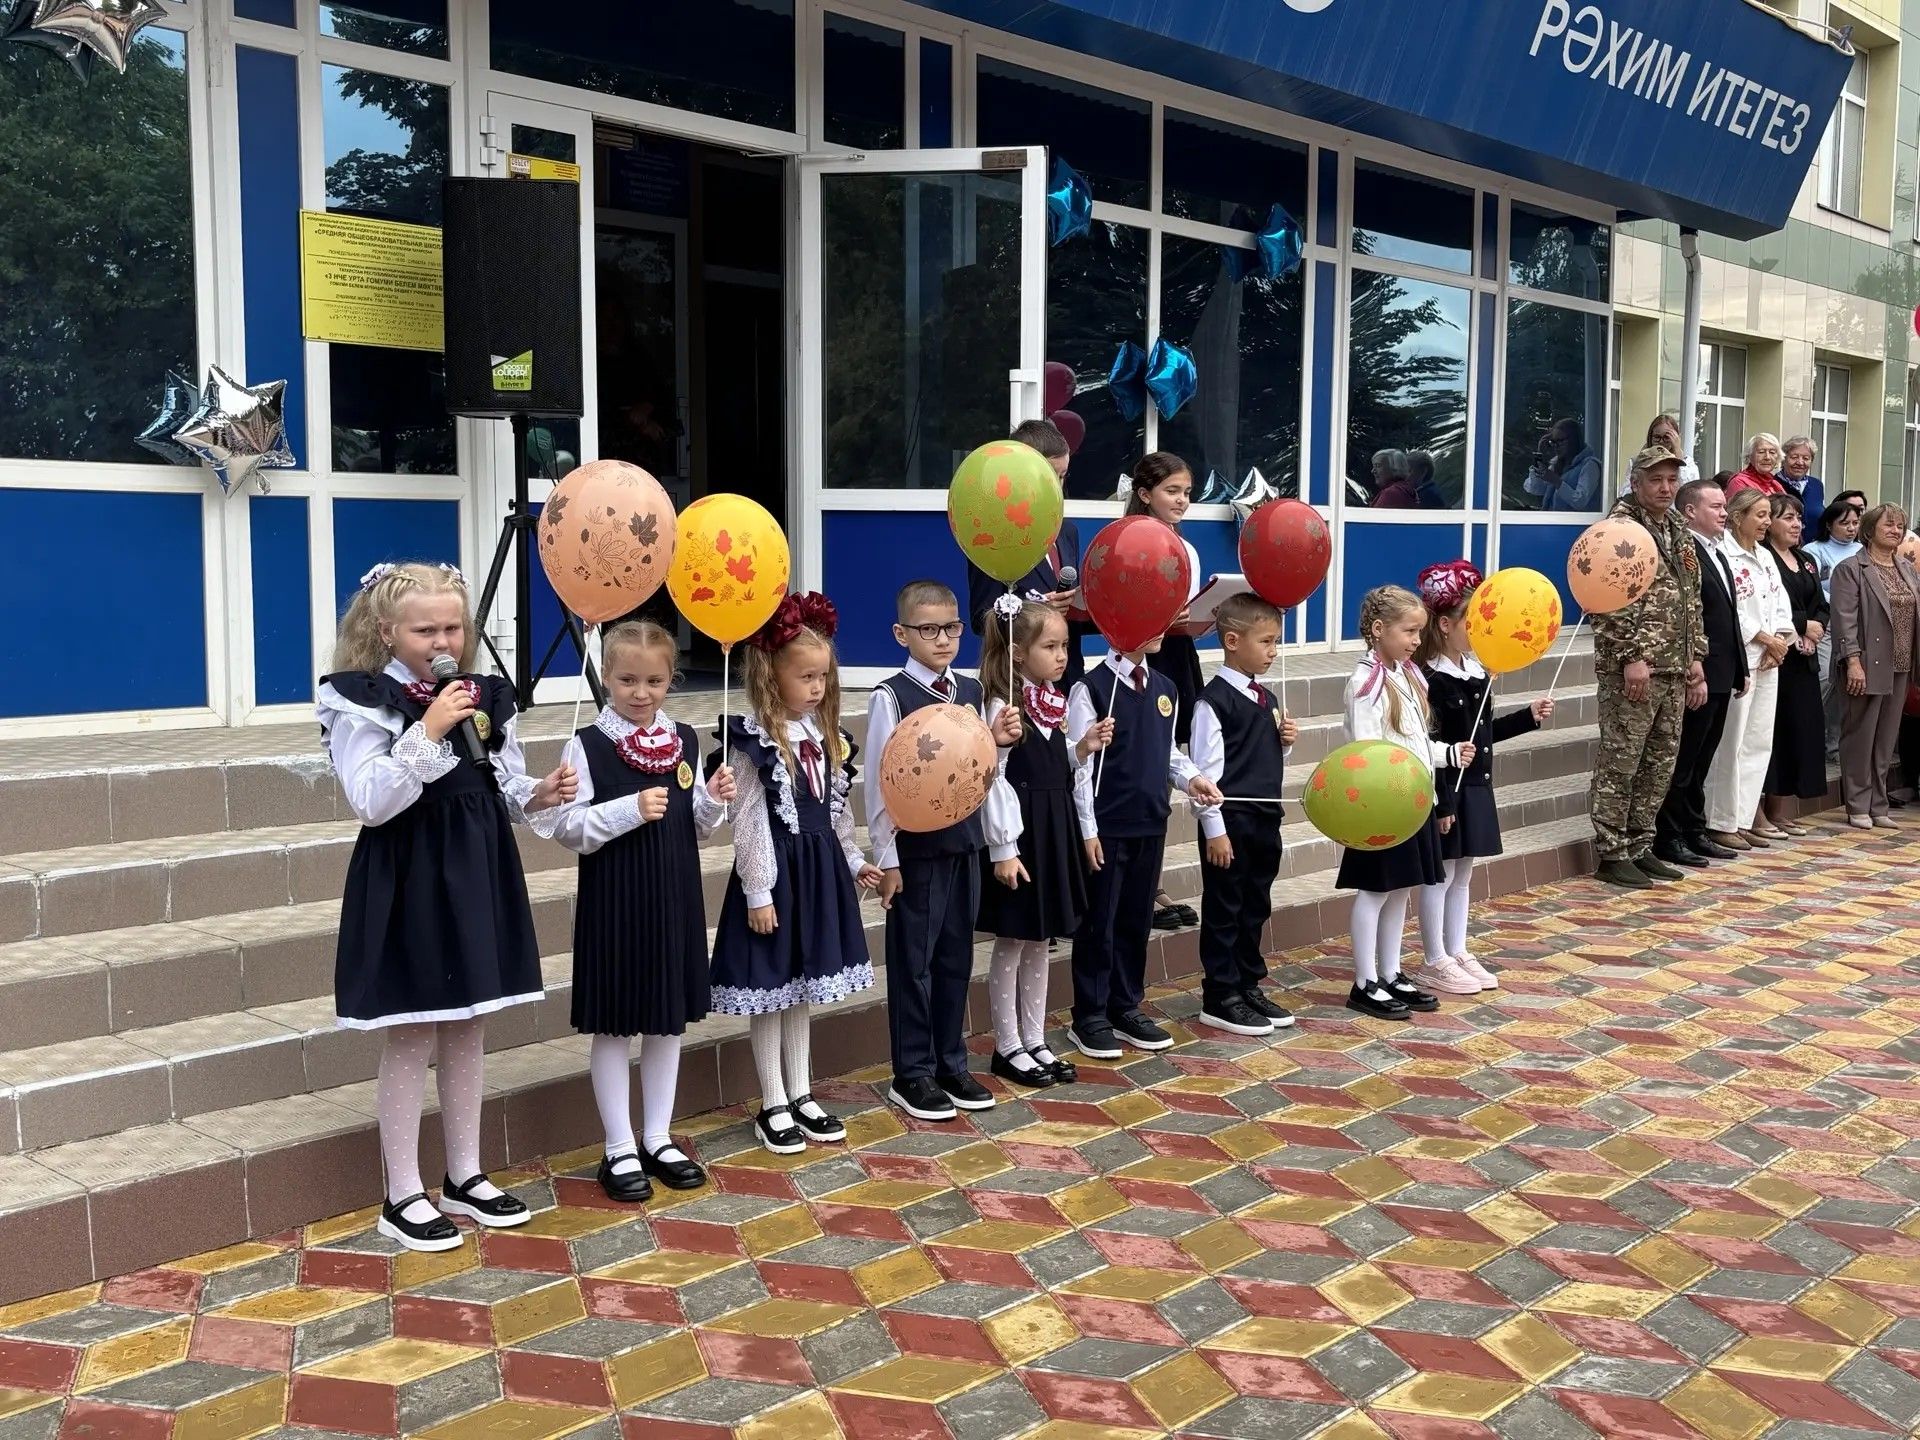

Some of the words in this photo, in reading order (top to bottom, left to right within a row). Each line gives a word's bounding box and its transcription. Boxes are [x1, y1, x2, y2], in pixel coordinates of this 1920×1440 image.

[1529, 0, 1691, 109] РӘХИМ
[1686, 61, 1811, 154] ИТЕГЕЗ
[366, 277, 392, 285] ГОМУМИ
